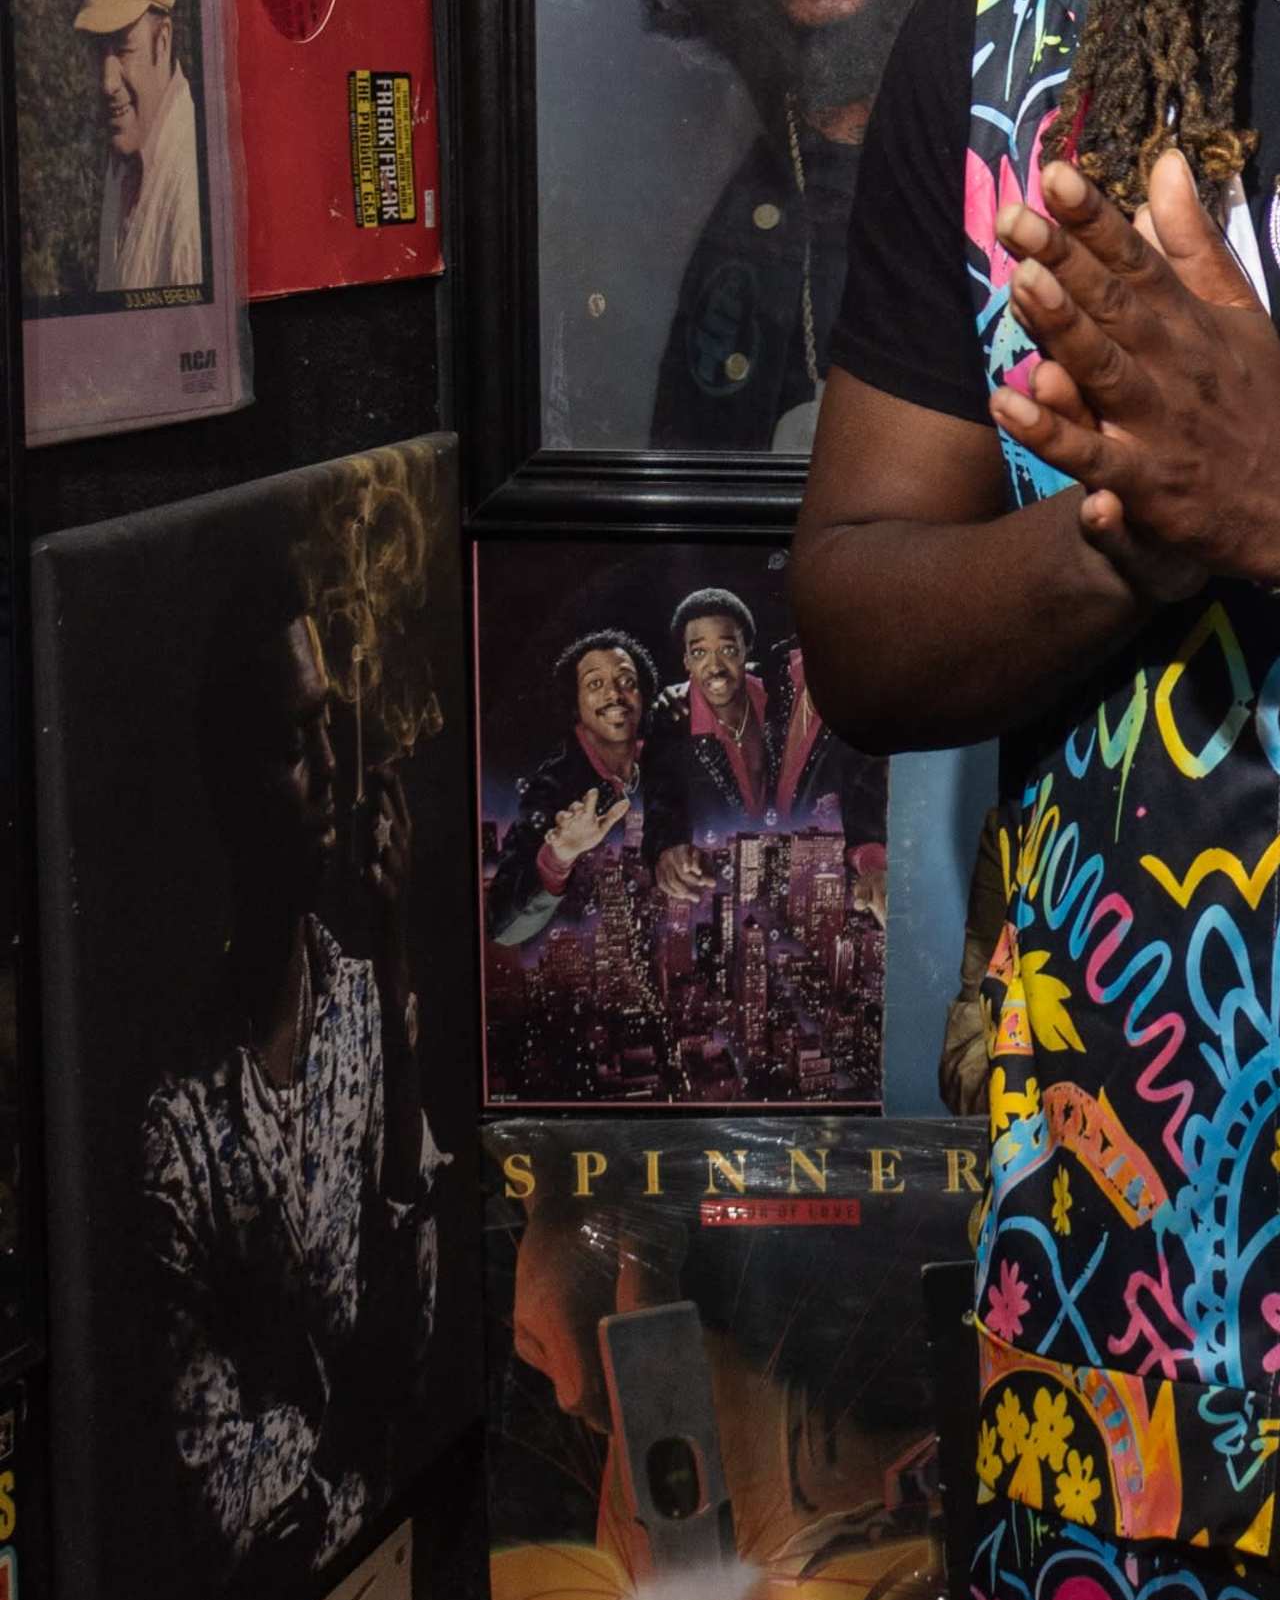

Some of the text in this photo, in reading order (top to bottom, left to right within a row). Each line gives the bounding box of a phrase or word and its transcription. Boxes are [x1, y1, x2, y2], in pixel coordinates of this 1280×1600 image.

[358, 78, 371, 103] THE
[375, 78, 395, 146] FREAK
[359, 111, 374, 184] PRODUCT
[180, 349, 217, 373] RCA
[502, 1148, 985, 1199] SPINNER
